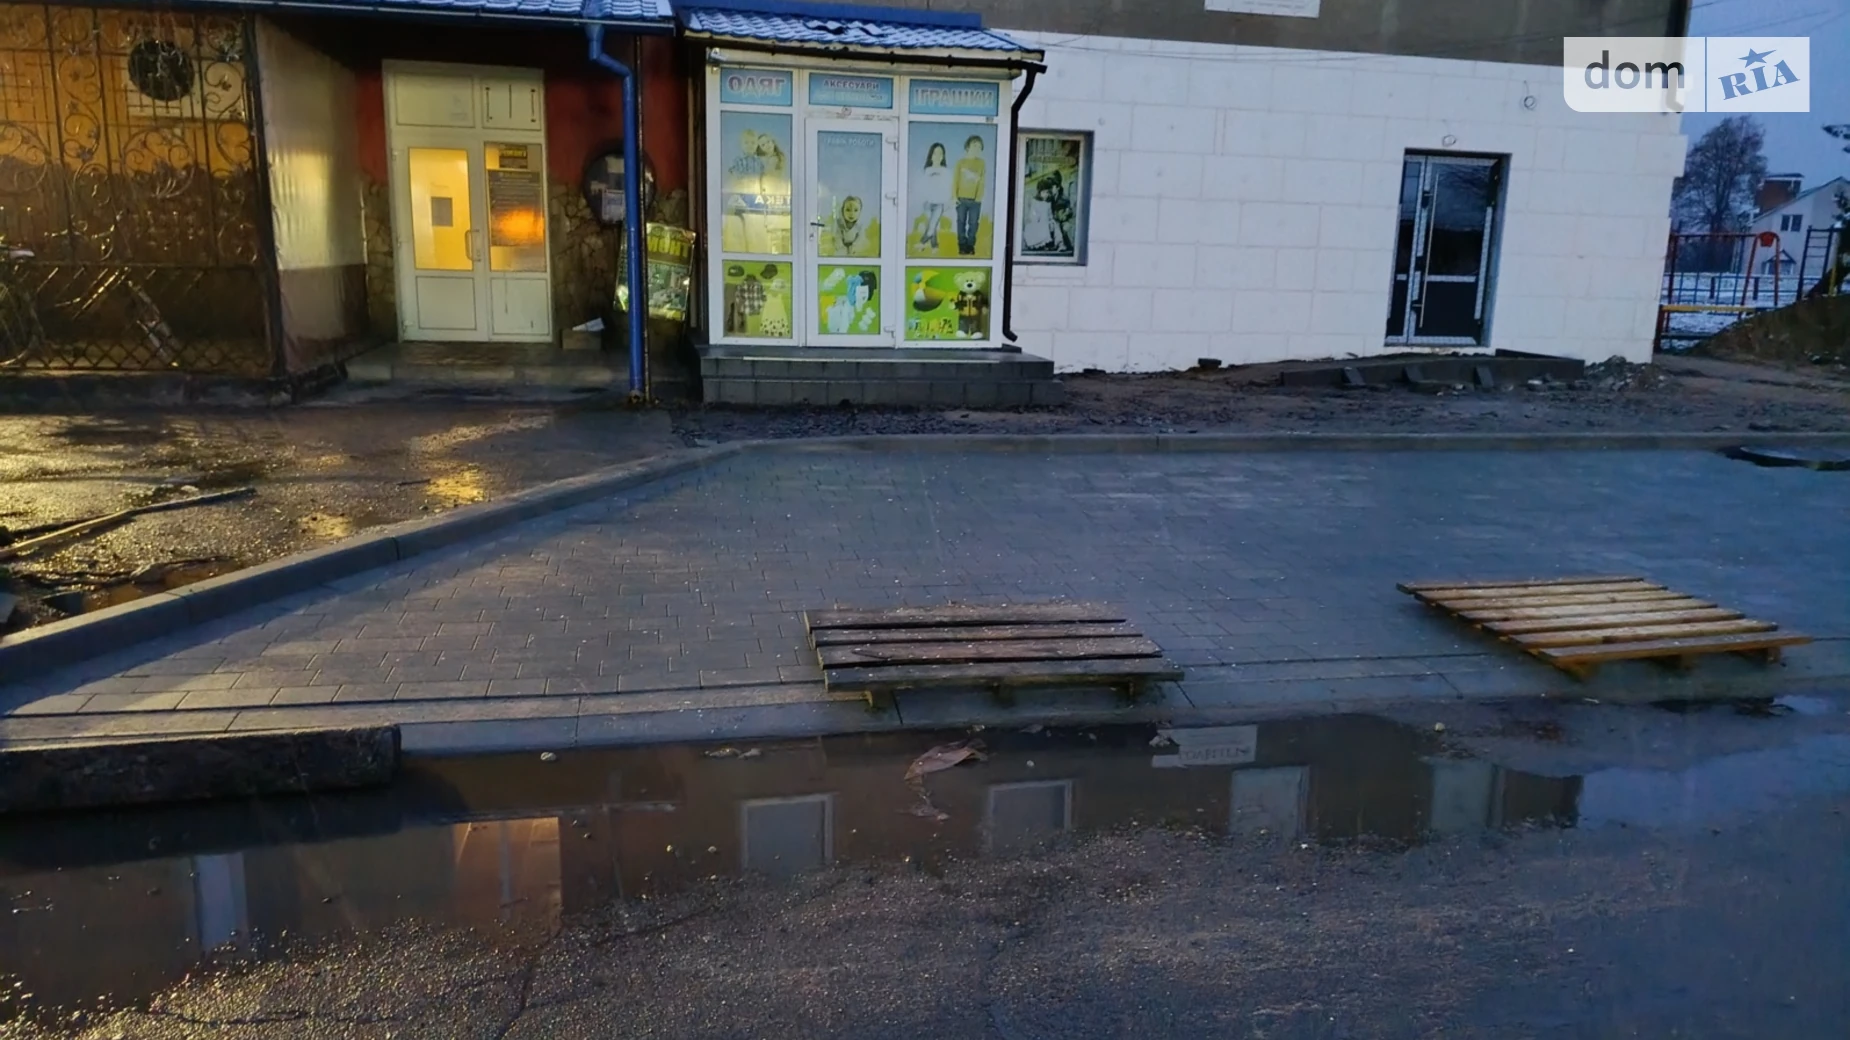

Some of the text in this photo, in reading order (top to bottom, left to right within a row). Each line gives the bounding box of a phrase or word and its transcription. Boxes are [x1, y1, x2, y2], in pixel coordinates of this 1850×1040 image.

[728, 75, 786, 98] ОДЯГ
[823, 79, 880, 91] АКСЕСУАРИ
[914, 88, 993, 107] ІГРАШКИ
